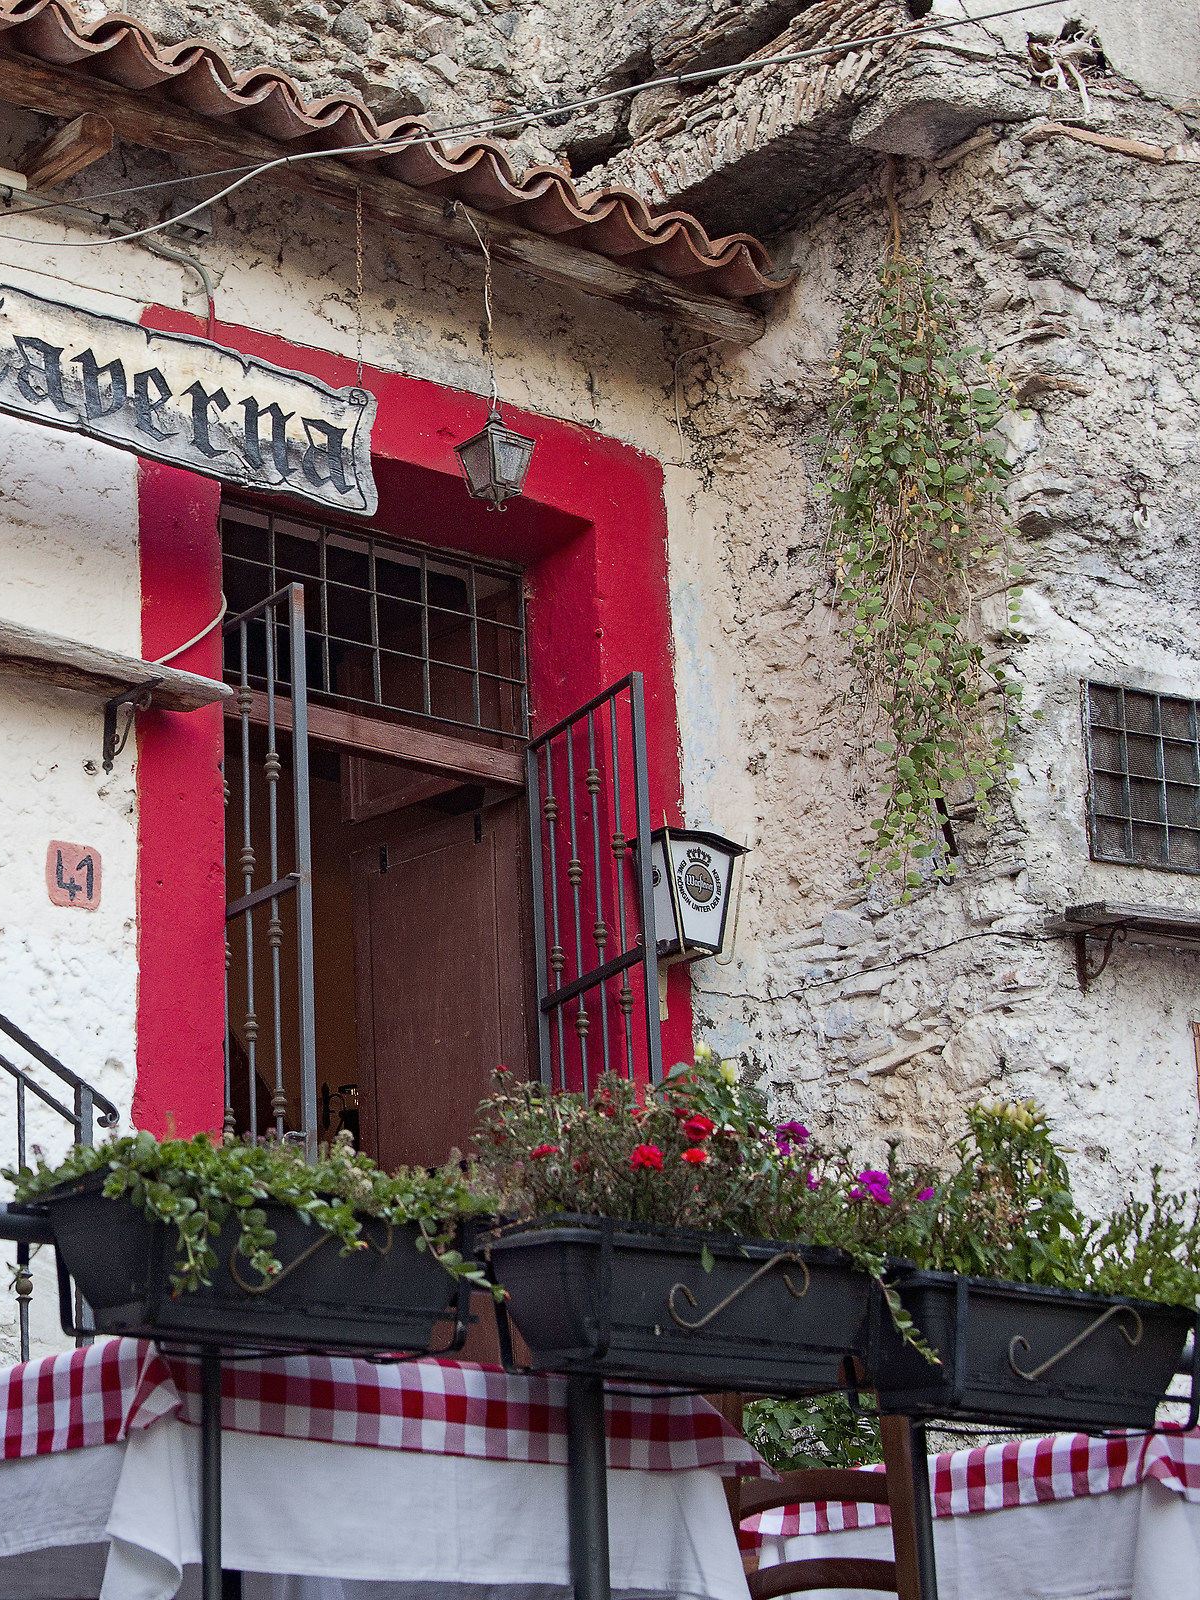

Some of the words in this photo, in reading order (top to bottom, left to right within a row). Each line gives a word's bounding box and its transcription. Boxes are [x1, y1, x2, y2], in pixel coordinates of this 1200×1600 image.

[56, 849, 94, 901] 41
[691, 903, 712, 913] UNTER
[710, 896, 720, 909] DEN
